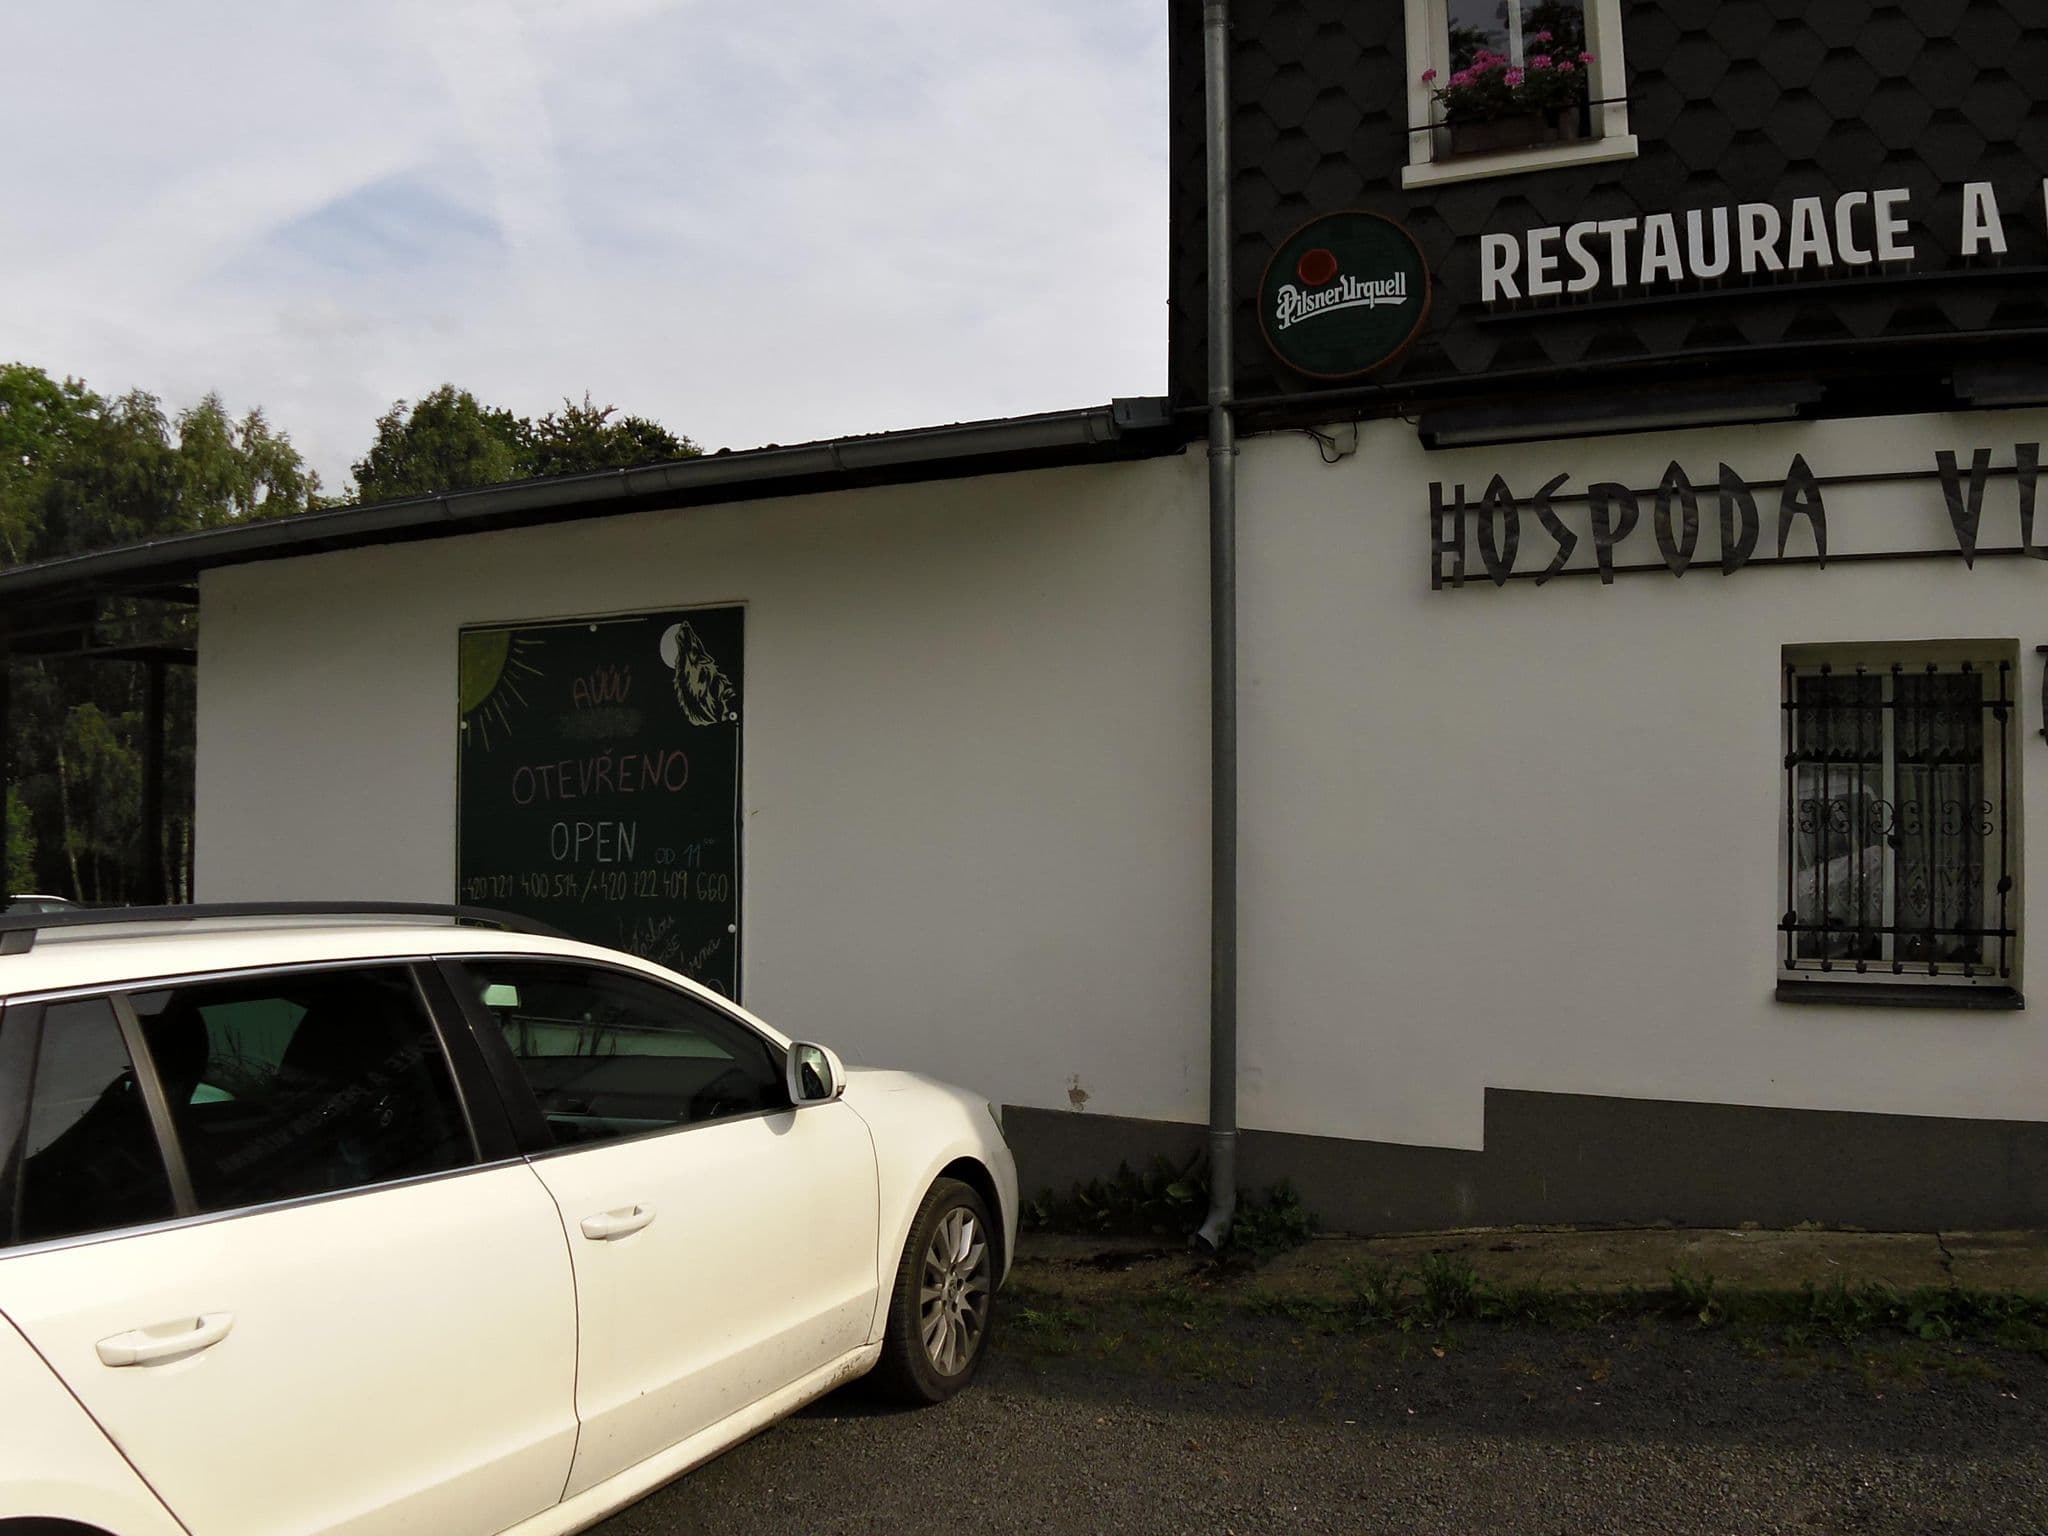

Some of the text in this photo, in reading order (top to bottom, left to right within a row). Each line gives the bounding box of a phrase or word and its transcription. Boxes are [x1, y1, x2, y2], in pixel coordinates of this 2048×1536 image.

[1479, 187, 1917, 302] RESTAURACE
[1961, 181, 2008, 256] A
[1276, 271, 1407, 330] Pilsner Urquell
[1428, 452, 1828, 591] HOSPODA
[512, 747, 690, 805] OTEVŘENO
[551, 820, 638, 864] OPEN
[696, 871, 730, 903] 660
